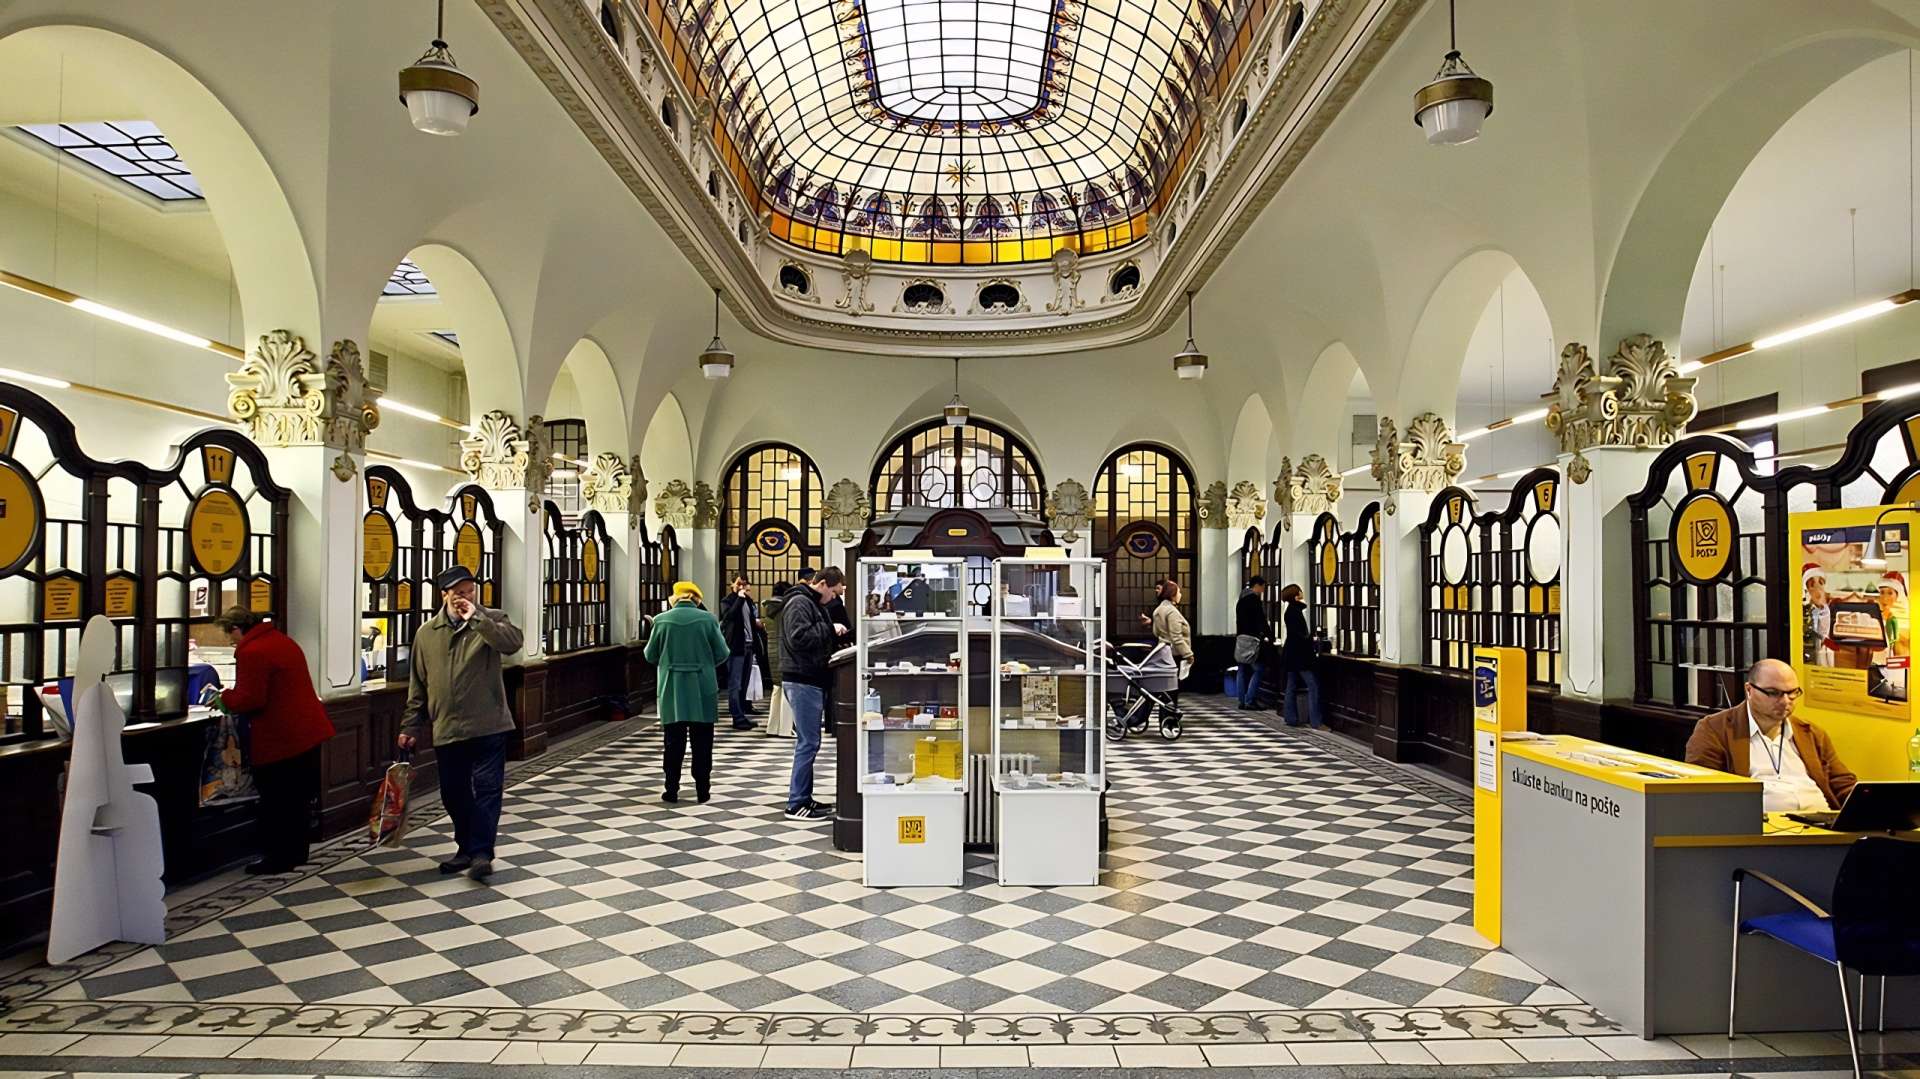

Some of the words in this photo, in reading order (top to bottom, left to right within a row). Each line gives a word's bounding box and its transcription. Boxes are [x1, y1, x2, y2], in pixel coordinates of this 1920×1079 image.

[210, 453, 223, 472] 11
[1698, 463, 1707, 480] 7
[372, 485, 382, 498] 12
[1543, 488, 1549, 502] 6
[1543, 775, 1573, 802] banku
[1575, 791, 1588, 807] na
